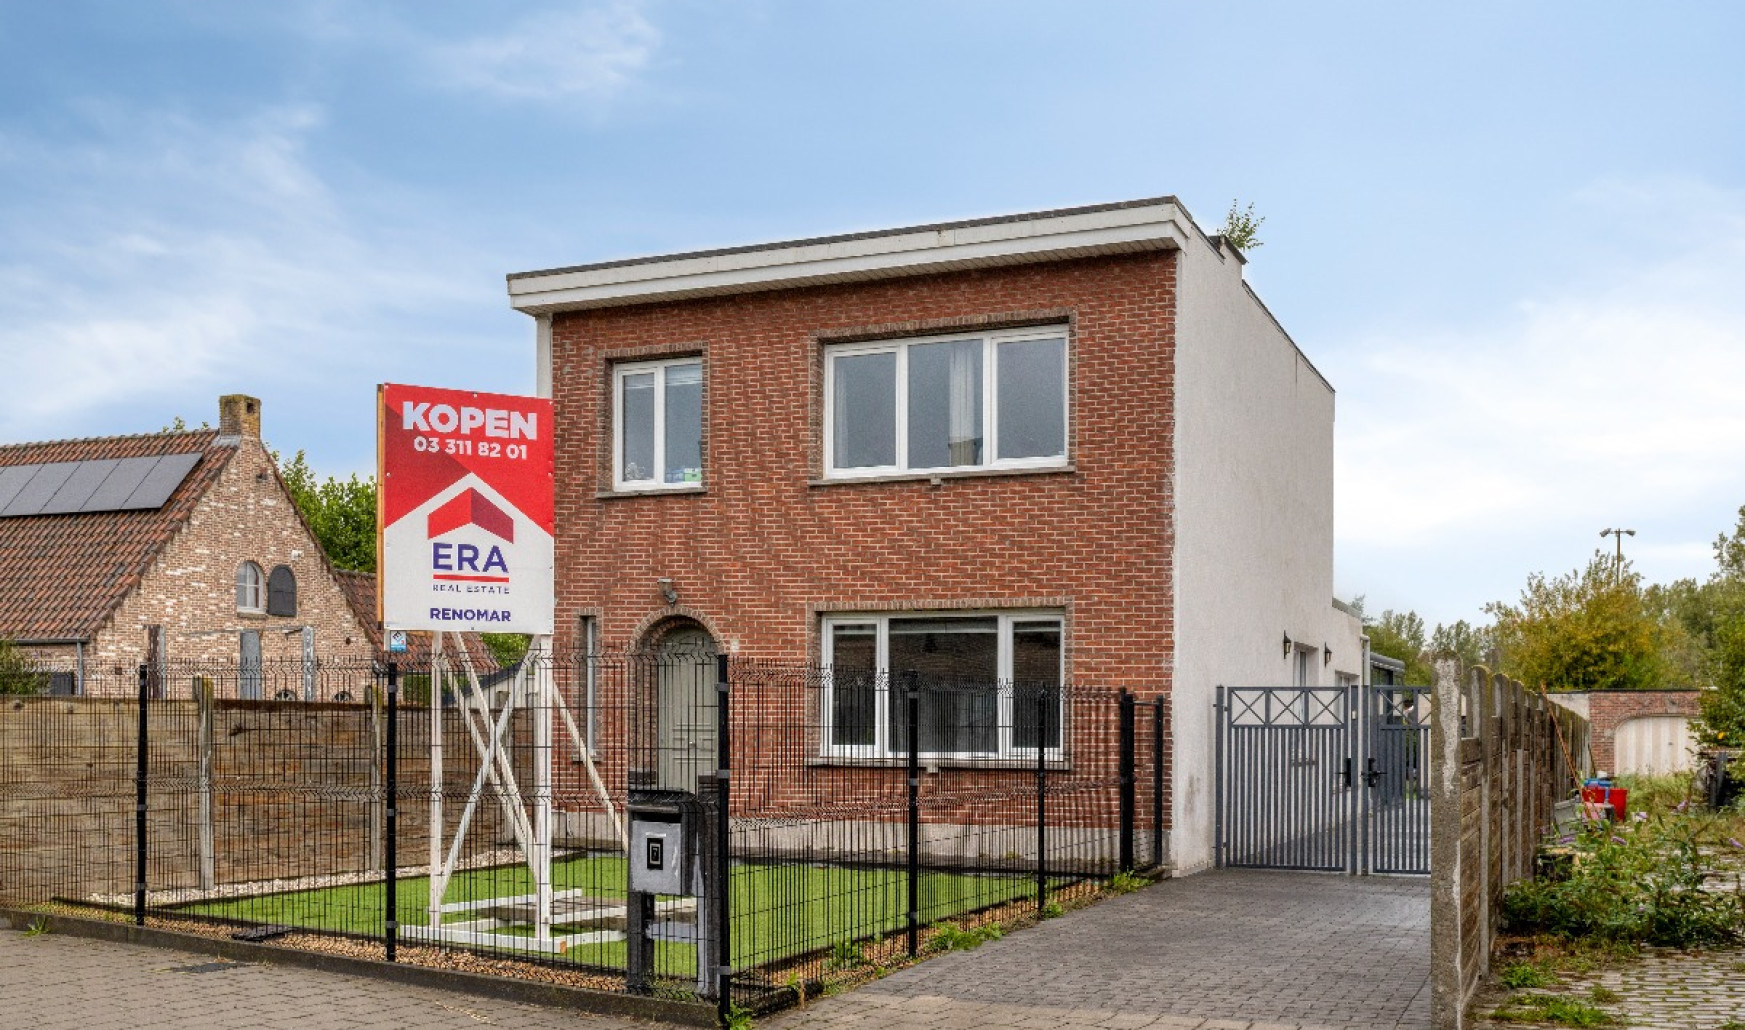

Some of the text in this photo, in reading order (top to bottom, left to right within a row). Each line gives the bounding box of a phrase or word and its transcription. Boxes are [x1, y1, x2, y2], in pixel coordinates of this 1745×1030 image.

[402, 401, 537, 440] KOPEN
[413, 436, 527, 459] 03 311 82 01
[432, 542, 509, 573] ERA
[433, 584, 509, 595] REAL ESTATE
[430, 607, 511, 622] RENOMAR
